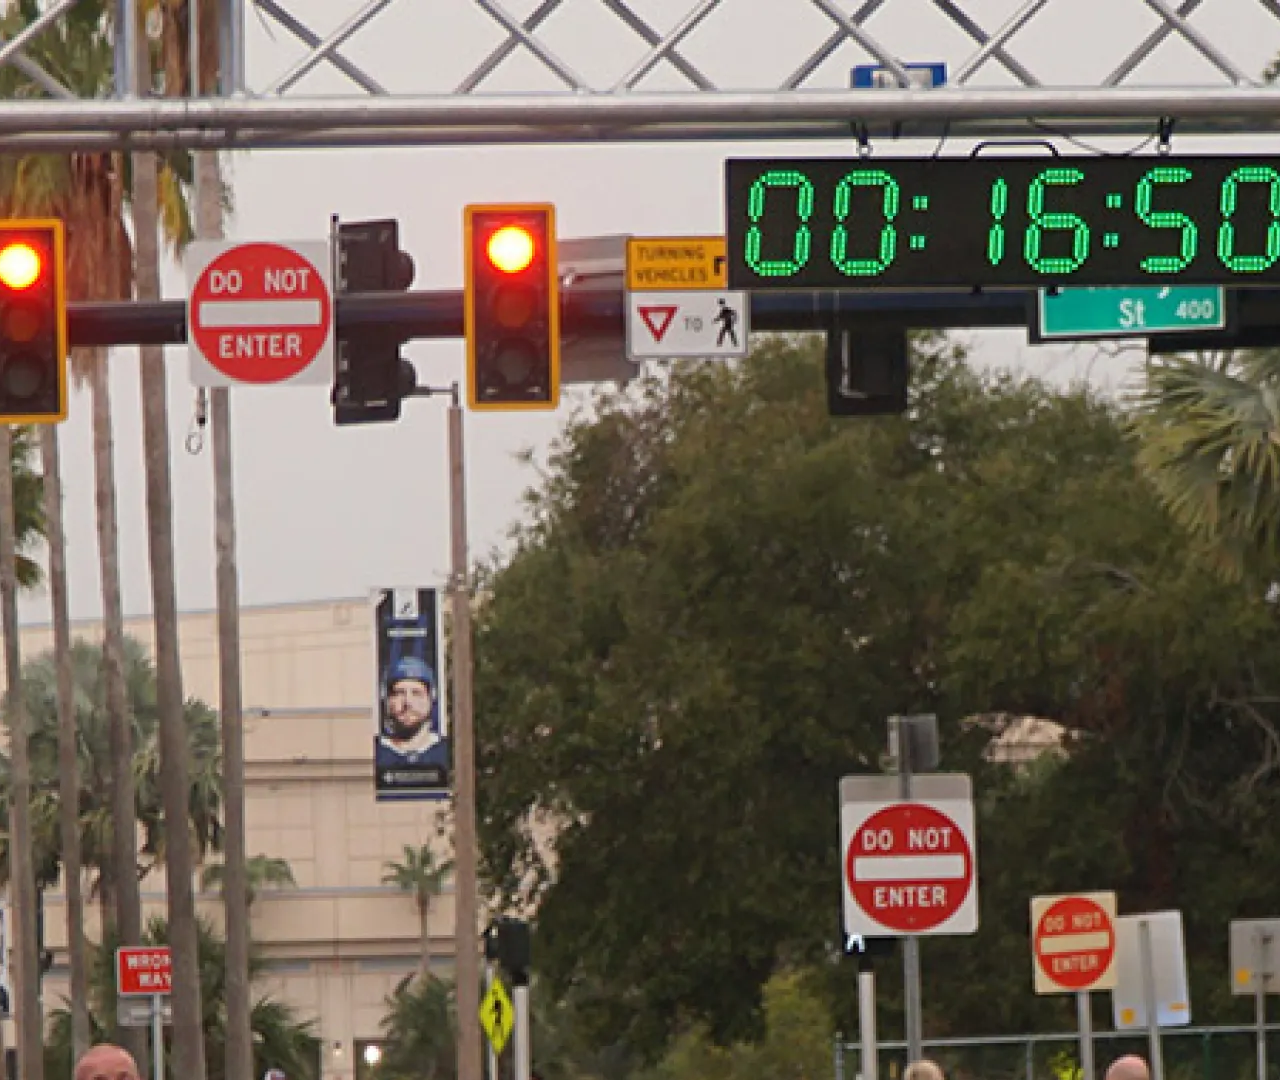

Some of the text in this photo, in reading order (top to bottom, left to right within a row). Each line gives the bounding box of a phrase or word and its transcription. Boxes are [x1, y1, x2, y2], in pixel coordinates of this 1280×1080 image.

[636, 244, 706, 261] TURNING
[209, 266, 311, 294] DO NOT
[635, 266, 709, 283] VEHICLES
[1117, 297, 1215, 327] St 400
[684, 315, 703, 333] TO
[219, 332, 302, 359] ENTER
[862, 826, 952, 851] DO NOT
[874, 885, 947, 909] ENTER
[1044, 911, 1101, 933] DO NOT
[1052, 954, 1099, 973] ENTER
